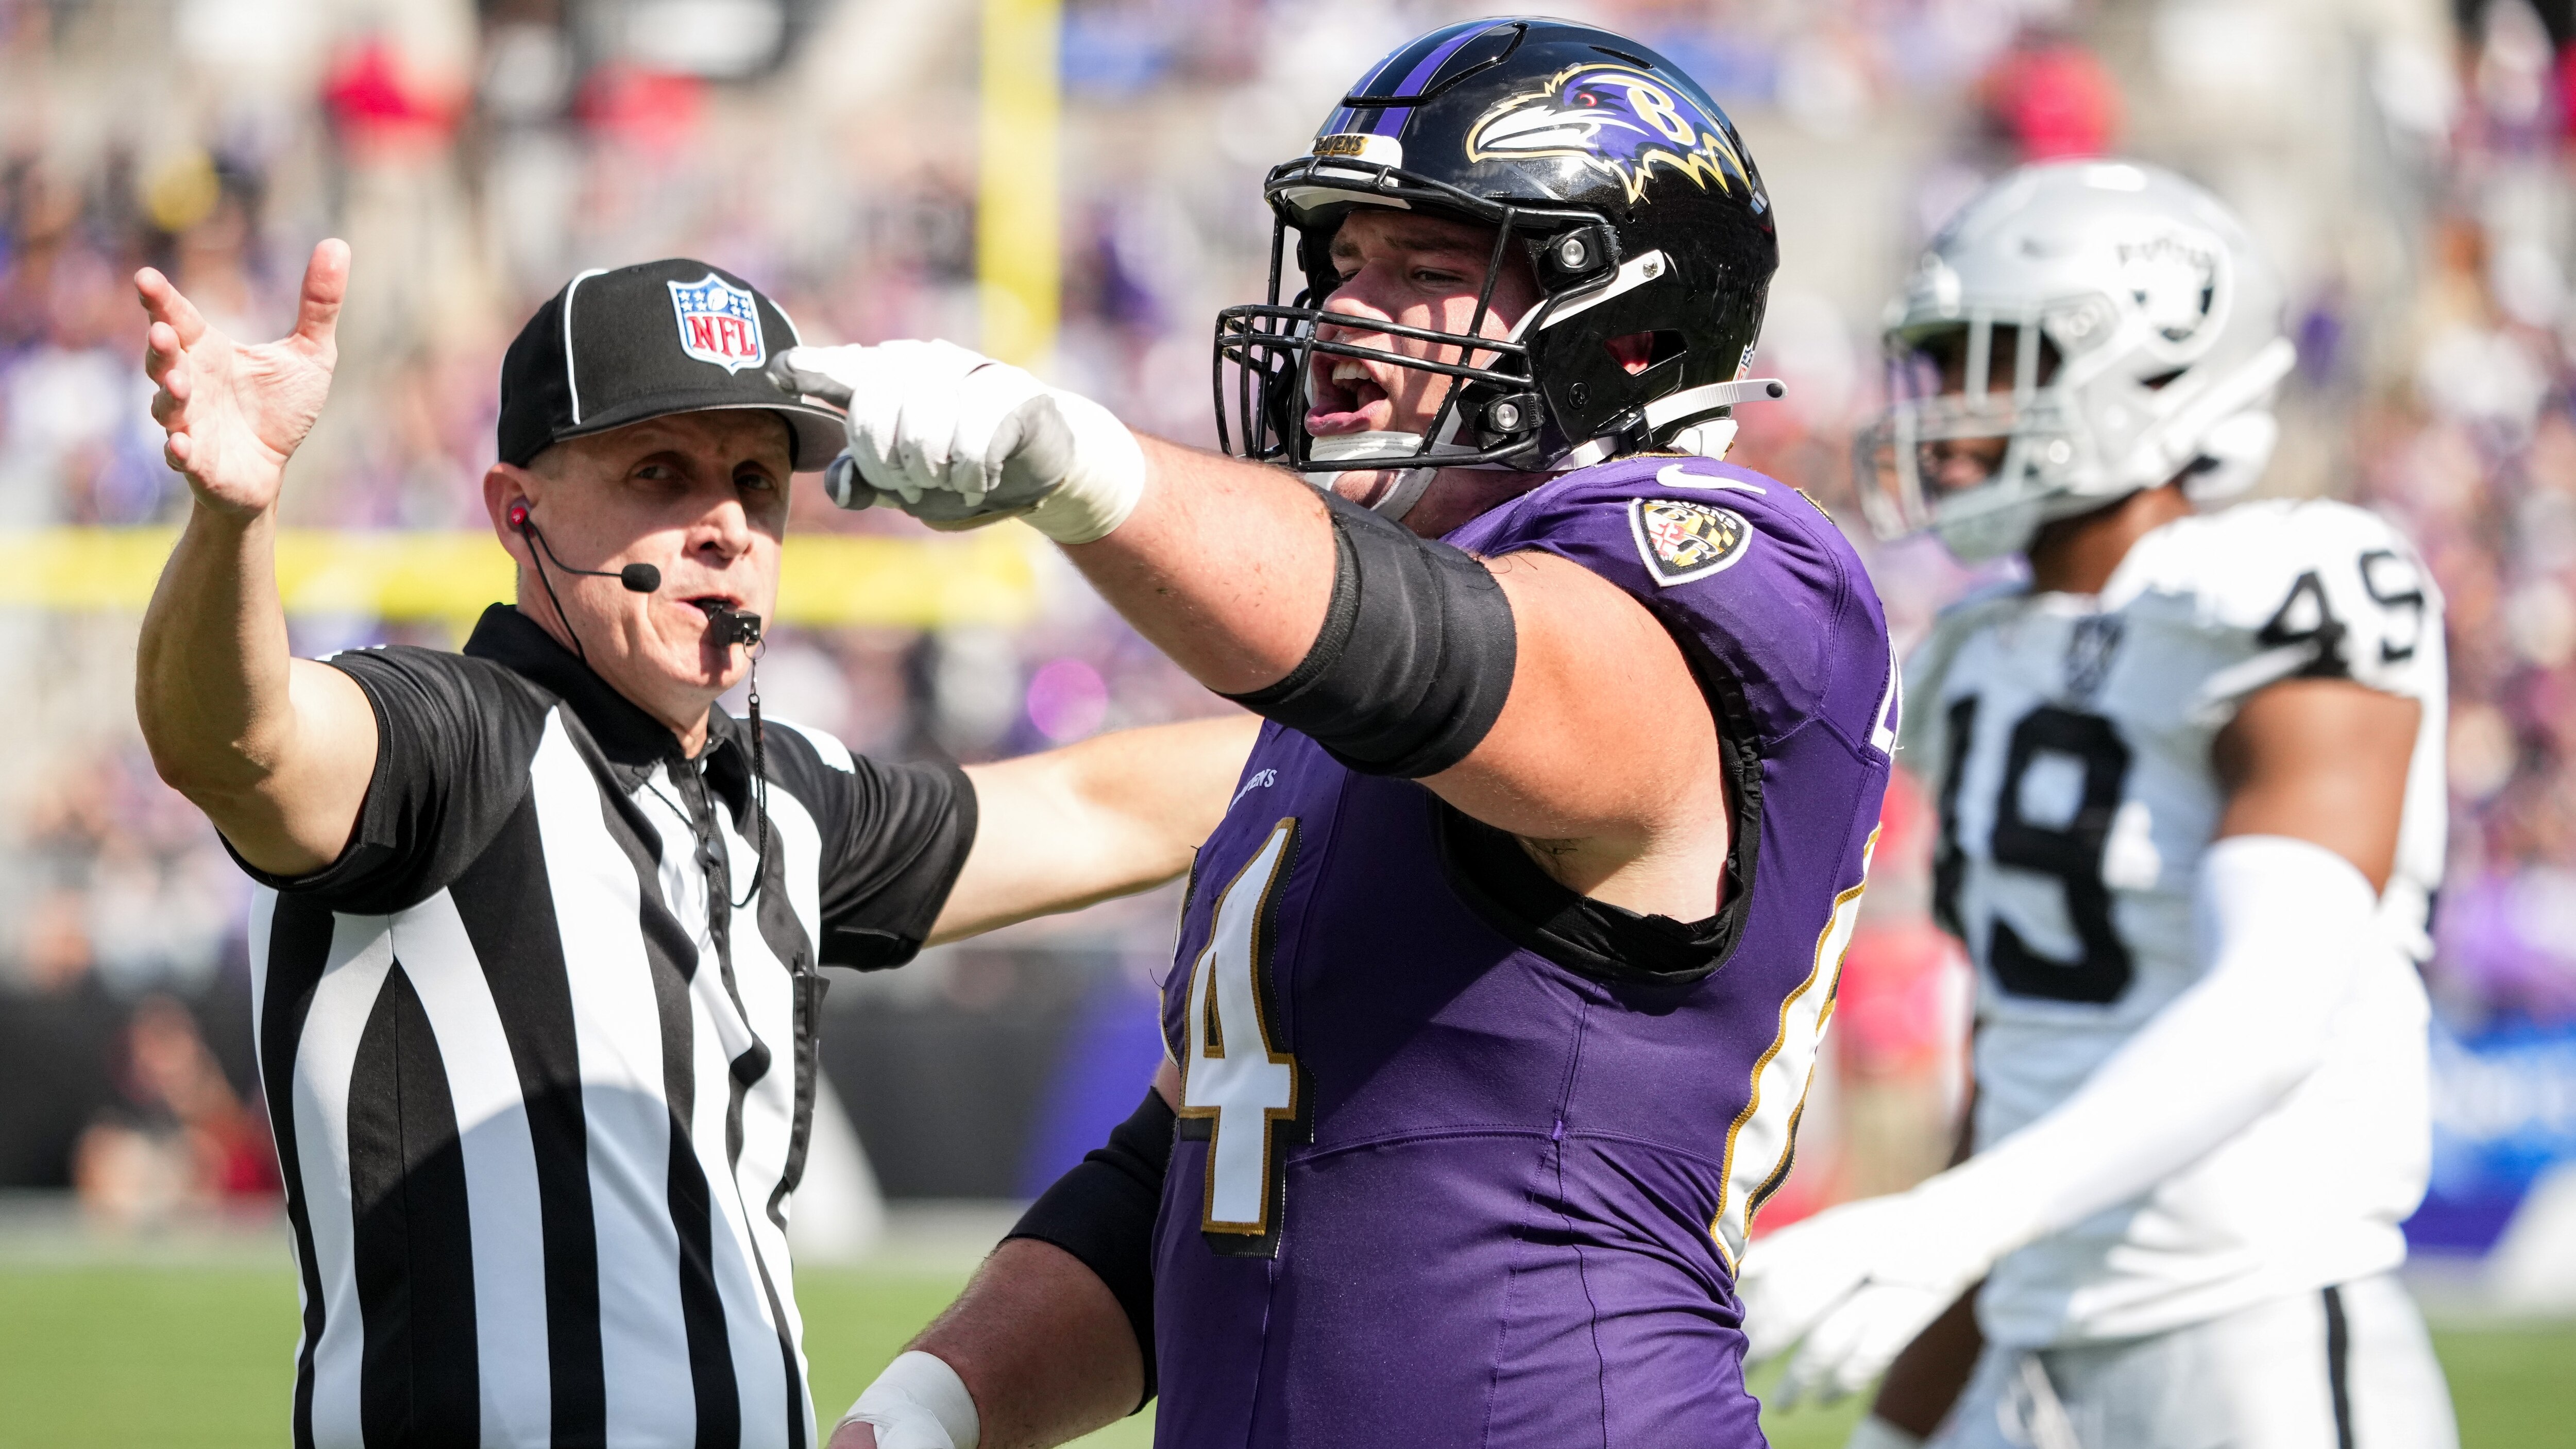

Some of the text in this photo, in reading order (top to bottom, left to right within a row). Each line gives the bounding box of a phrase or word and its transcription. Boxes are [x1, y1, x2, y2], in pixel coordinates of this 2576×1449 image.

[1626, 86, 1696, 146] B
[1312, 135, 1368, 156] RAVENS
[687, 316, 758, 357] NFL
[1528, 396, 1538, 428] Riddell
[1170, 817, 1306, 1247] 4
